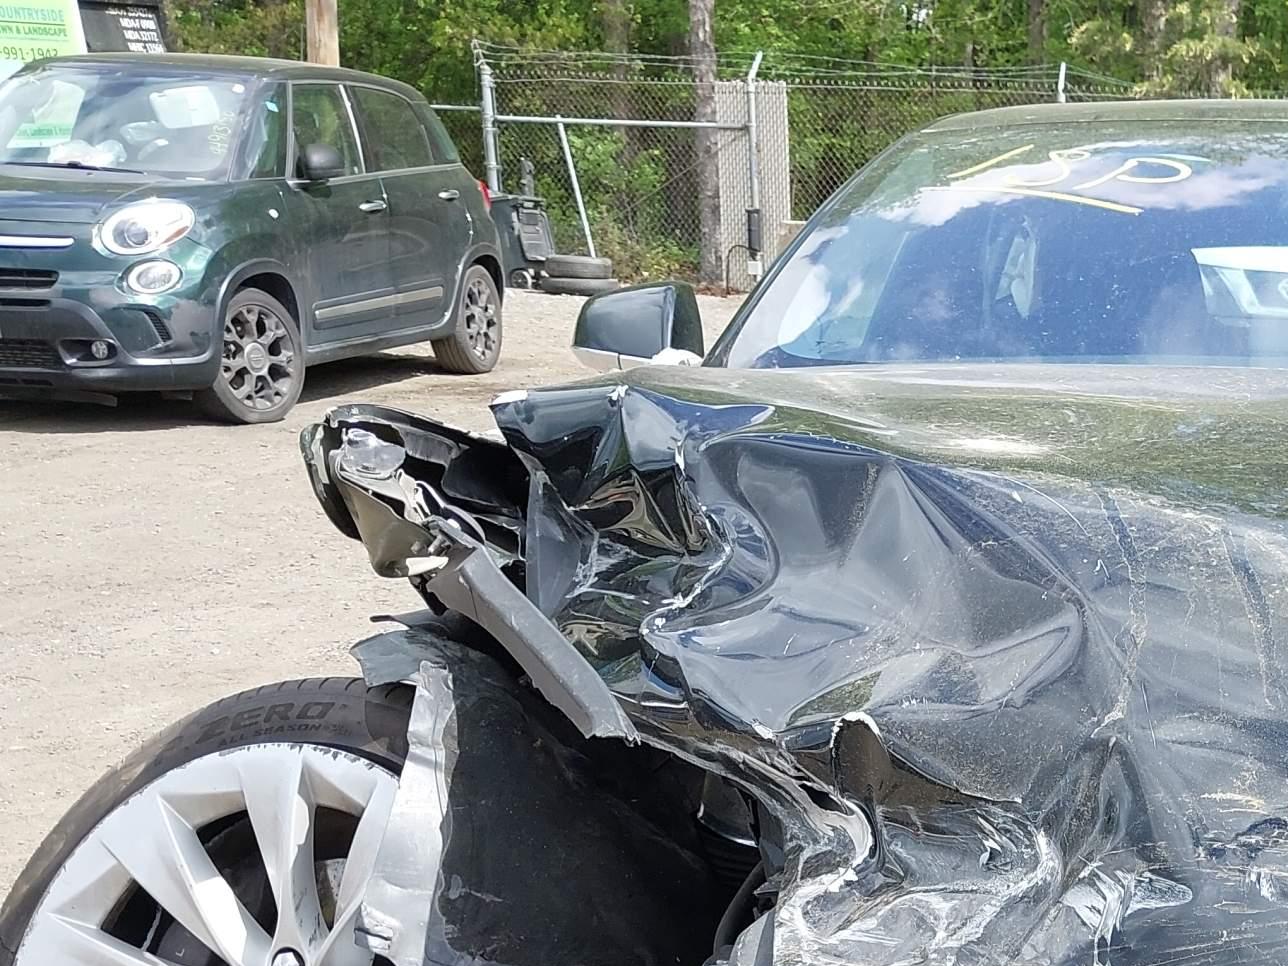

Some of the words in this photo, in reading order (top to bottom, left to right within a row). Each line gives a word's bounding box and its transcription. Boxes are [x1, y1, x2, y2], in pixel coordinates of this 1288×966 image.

[23, 26, 68, 37] LANDSCAPE
[195, 701, 336, 745] ZERO
[218, 732, 247, 749] ALL
[253, 722, 322, 738] SEASON
